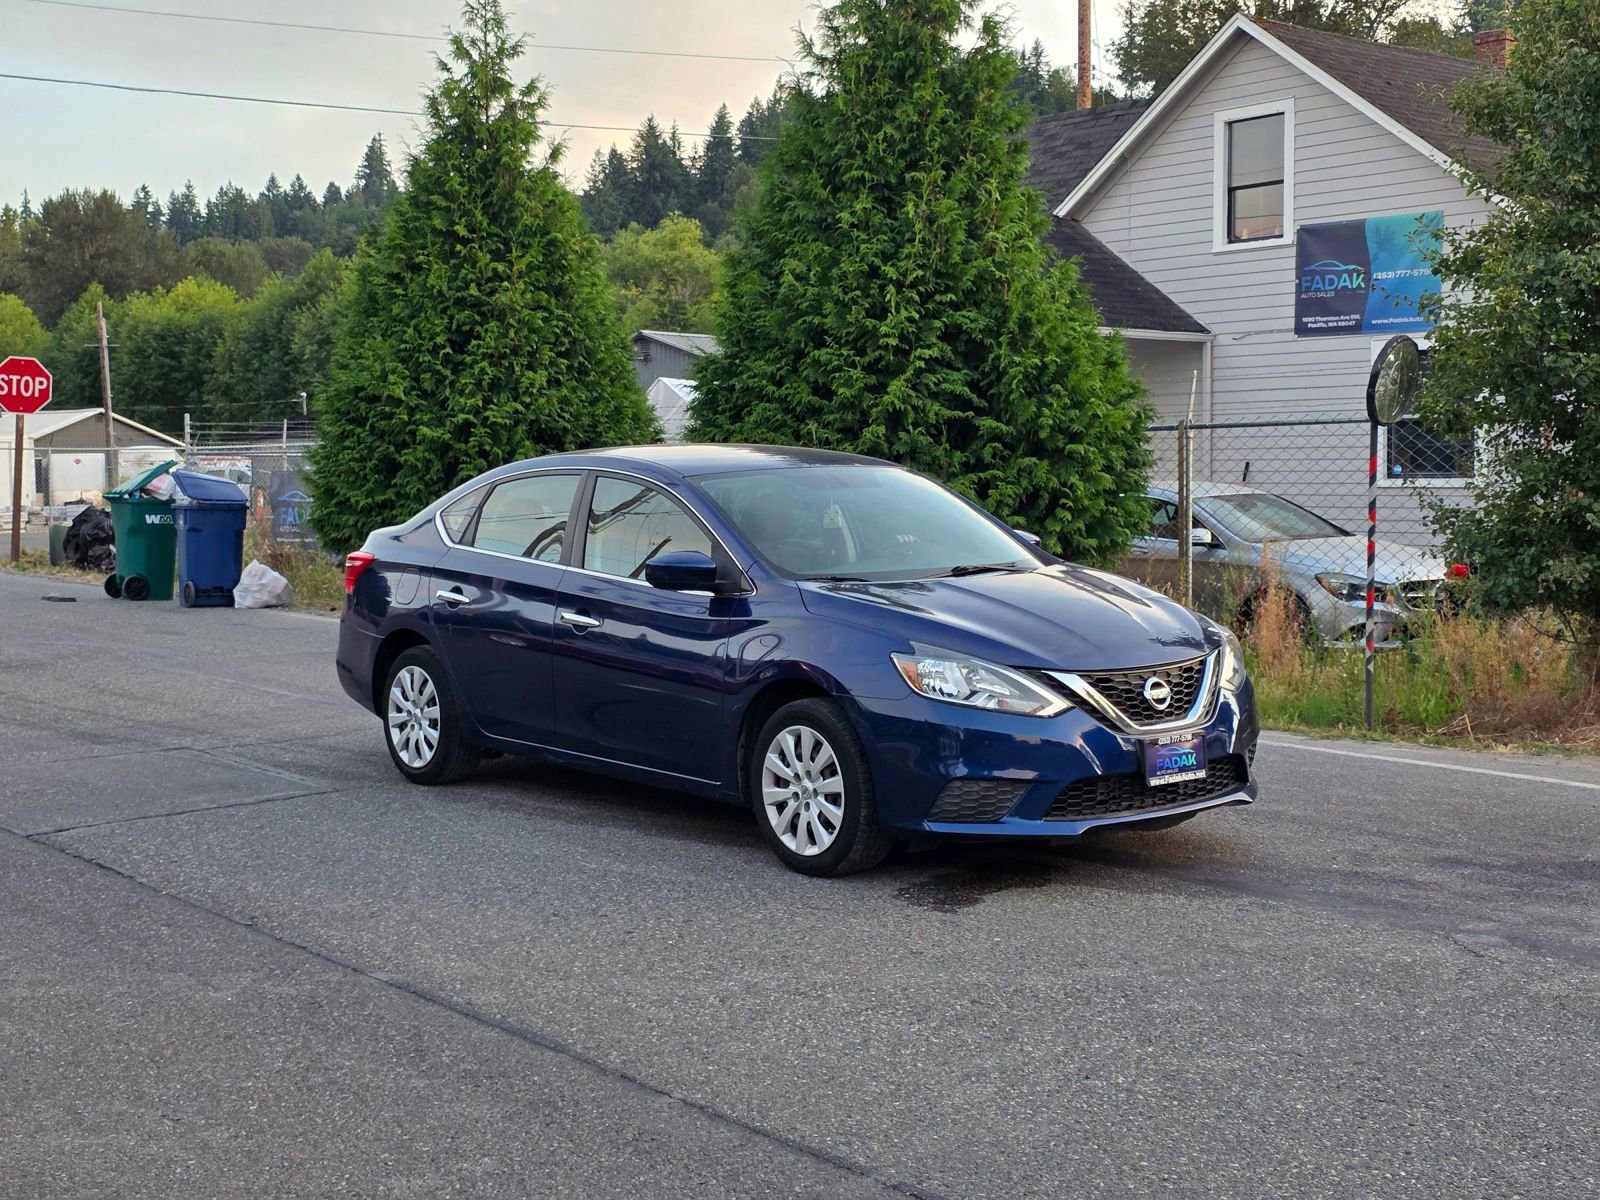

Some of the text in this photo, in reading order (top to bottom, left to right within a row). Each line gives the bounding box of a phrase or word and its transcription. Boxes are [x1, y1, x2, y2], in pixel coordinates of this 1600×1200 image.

[1395, 268, 1432, 278] 777-579
[1301, 272, 1366, 292] FADAK
[1317, 290, 1335, 298] SALES
[0, 373, 48, 398] STOP
[145, 514, 173, 524] WM
[1156, 753, 1197, 769] FADAK
